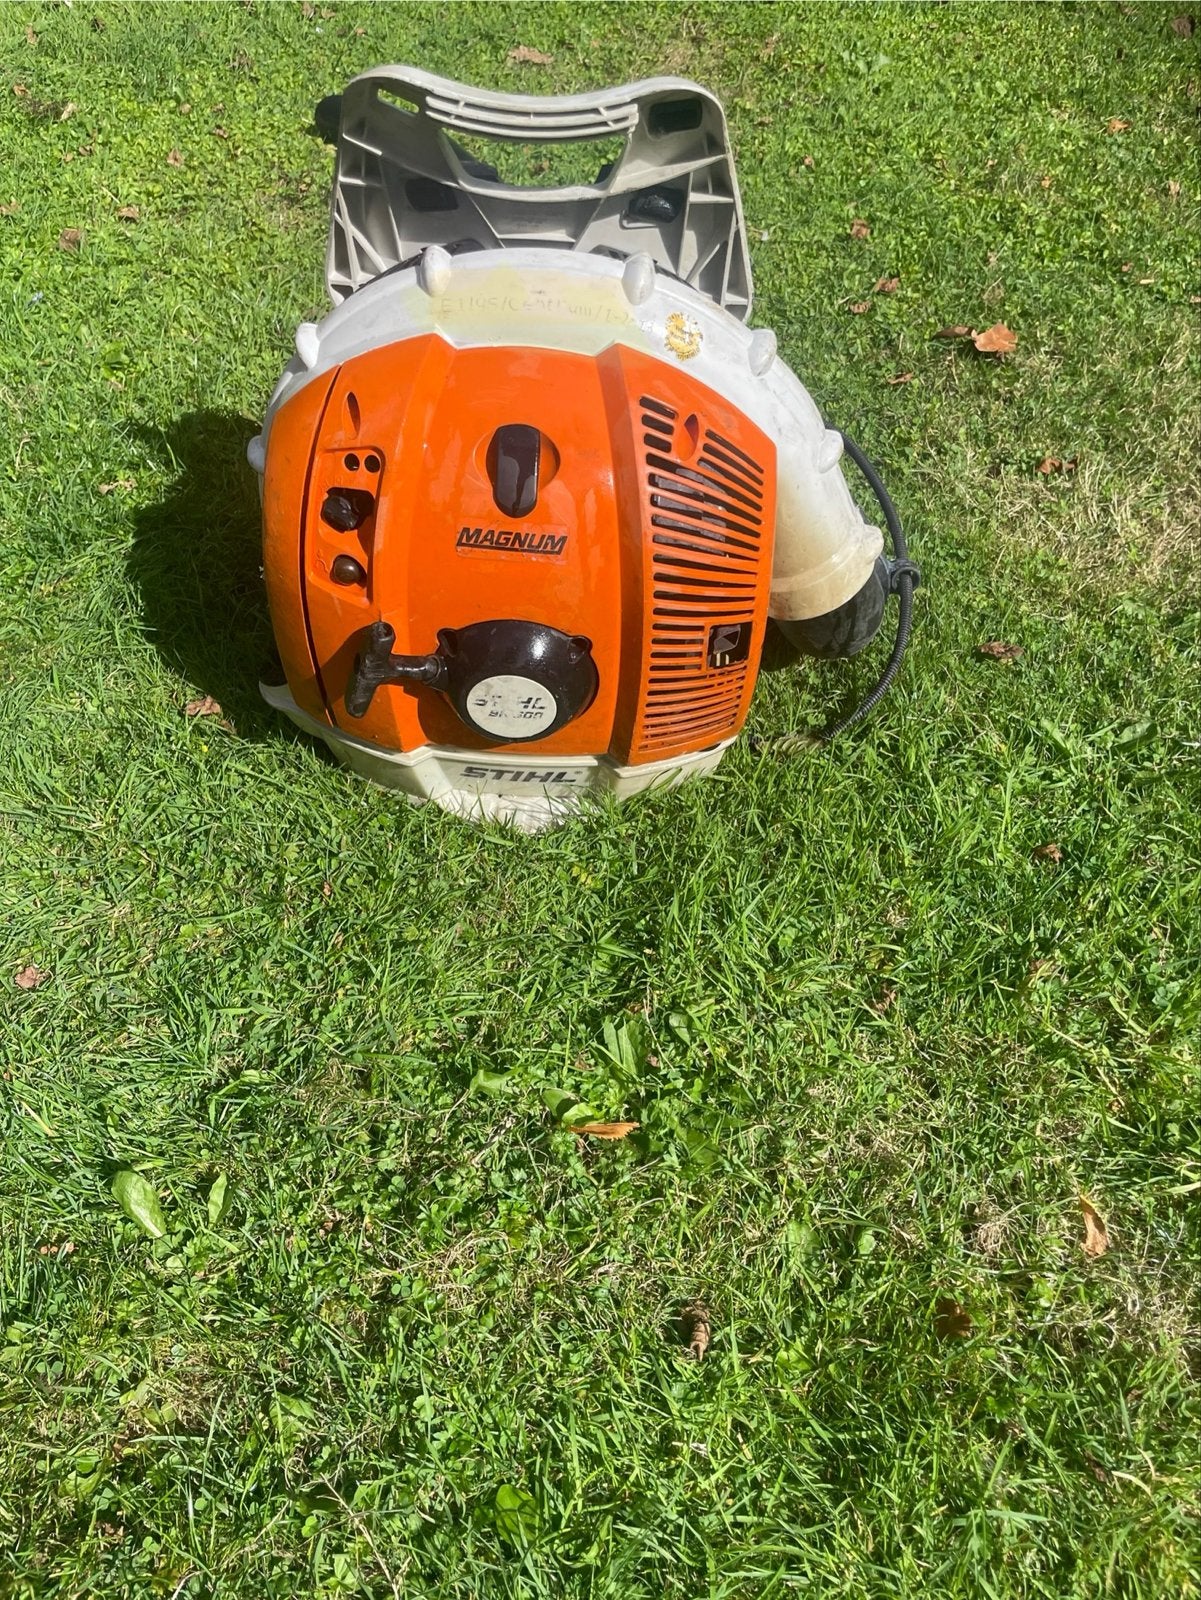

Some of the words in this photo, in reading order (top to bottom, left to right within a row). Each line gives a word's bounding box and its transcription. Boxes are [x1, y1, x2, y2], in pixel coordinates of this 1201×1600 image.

[457, 527, 568, 552] MAGNUM
[472, 694, 546, 710] STHL
[460, 766, 577, 783] STIHL
